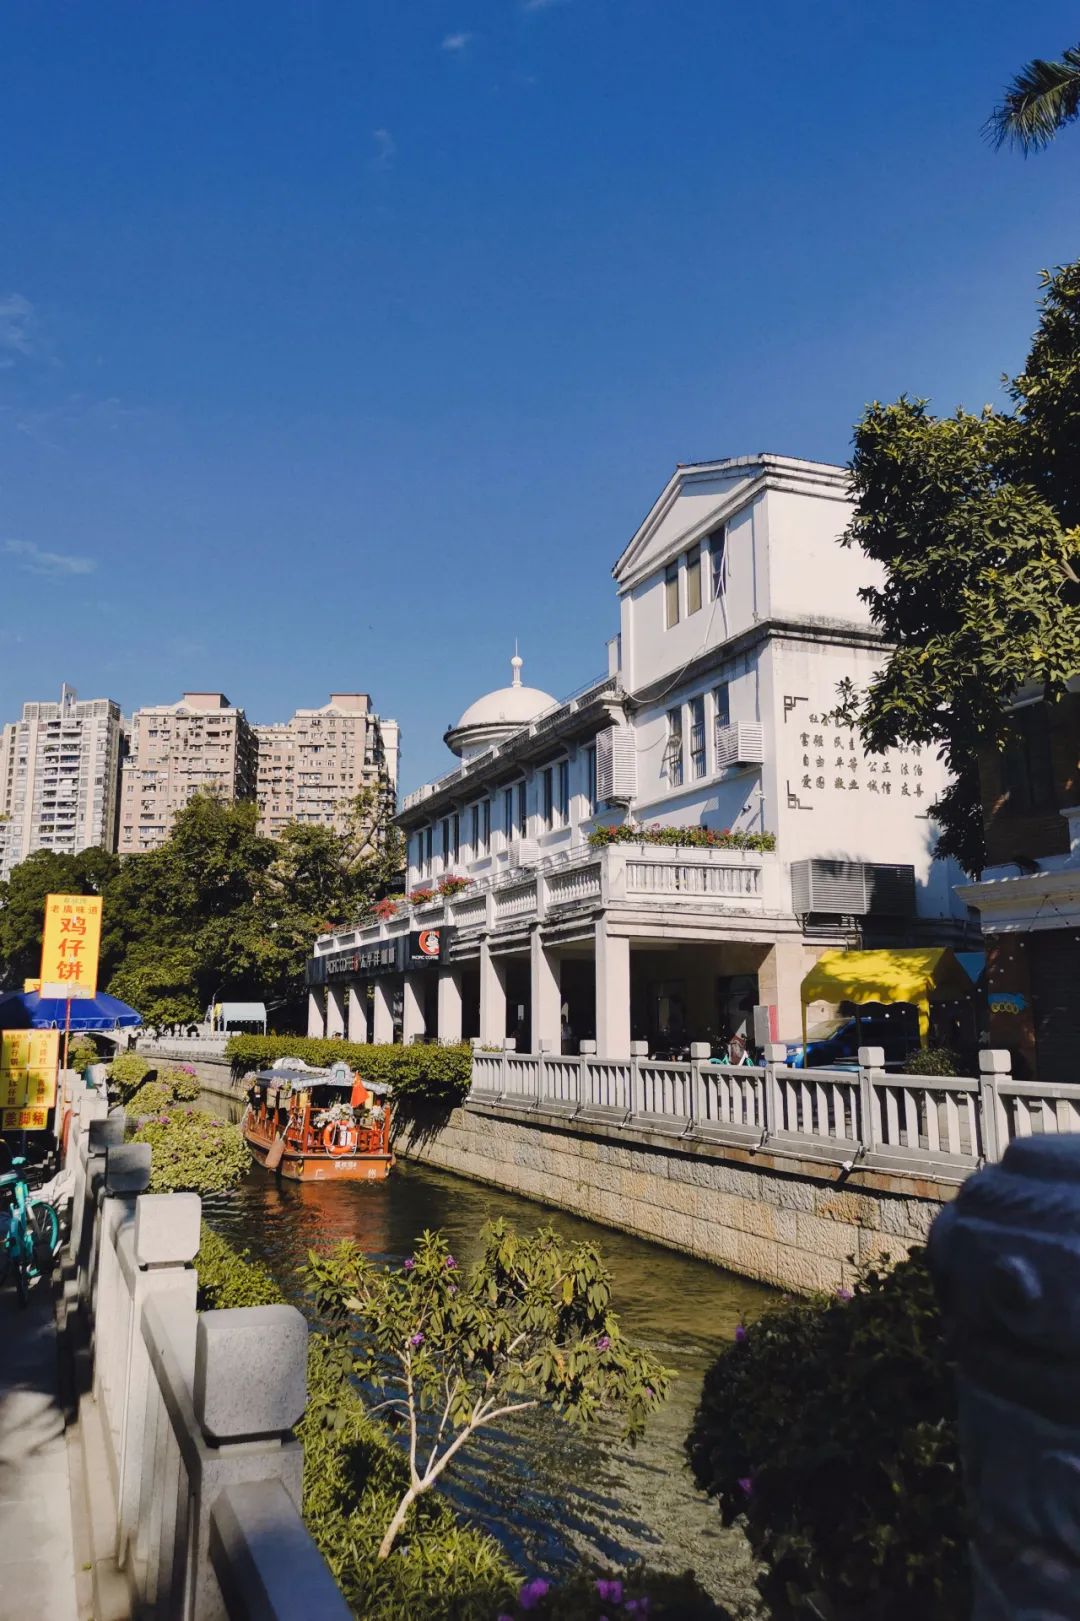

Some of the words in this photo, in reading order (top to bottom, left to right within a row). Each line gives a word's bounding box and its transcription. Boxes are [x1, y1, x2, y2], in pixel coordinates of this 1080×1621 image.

[834, 736, 855, 751] 民主
[802, 753, 825, 768] 自由
[834, 756, 858, 773] 平等
[867, 761, 891, 774] 公正
[901, 782, 924, 798] 友善
[56, 916, 87, 980] 鸡仔饼
